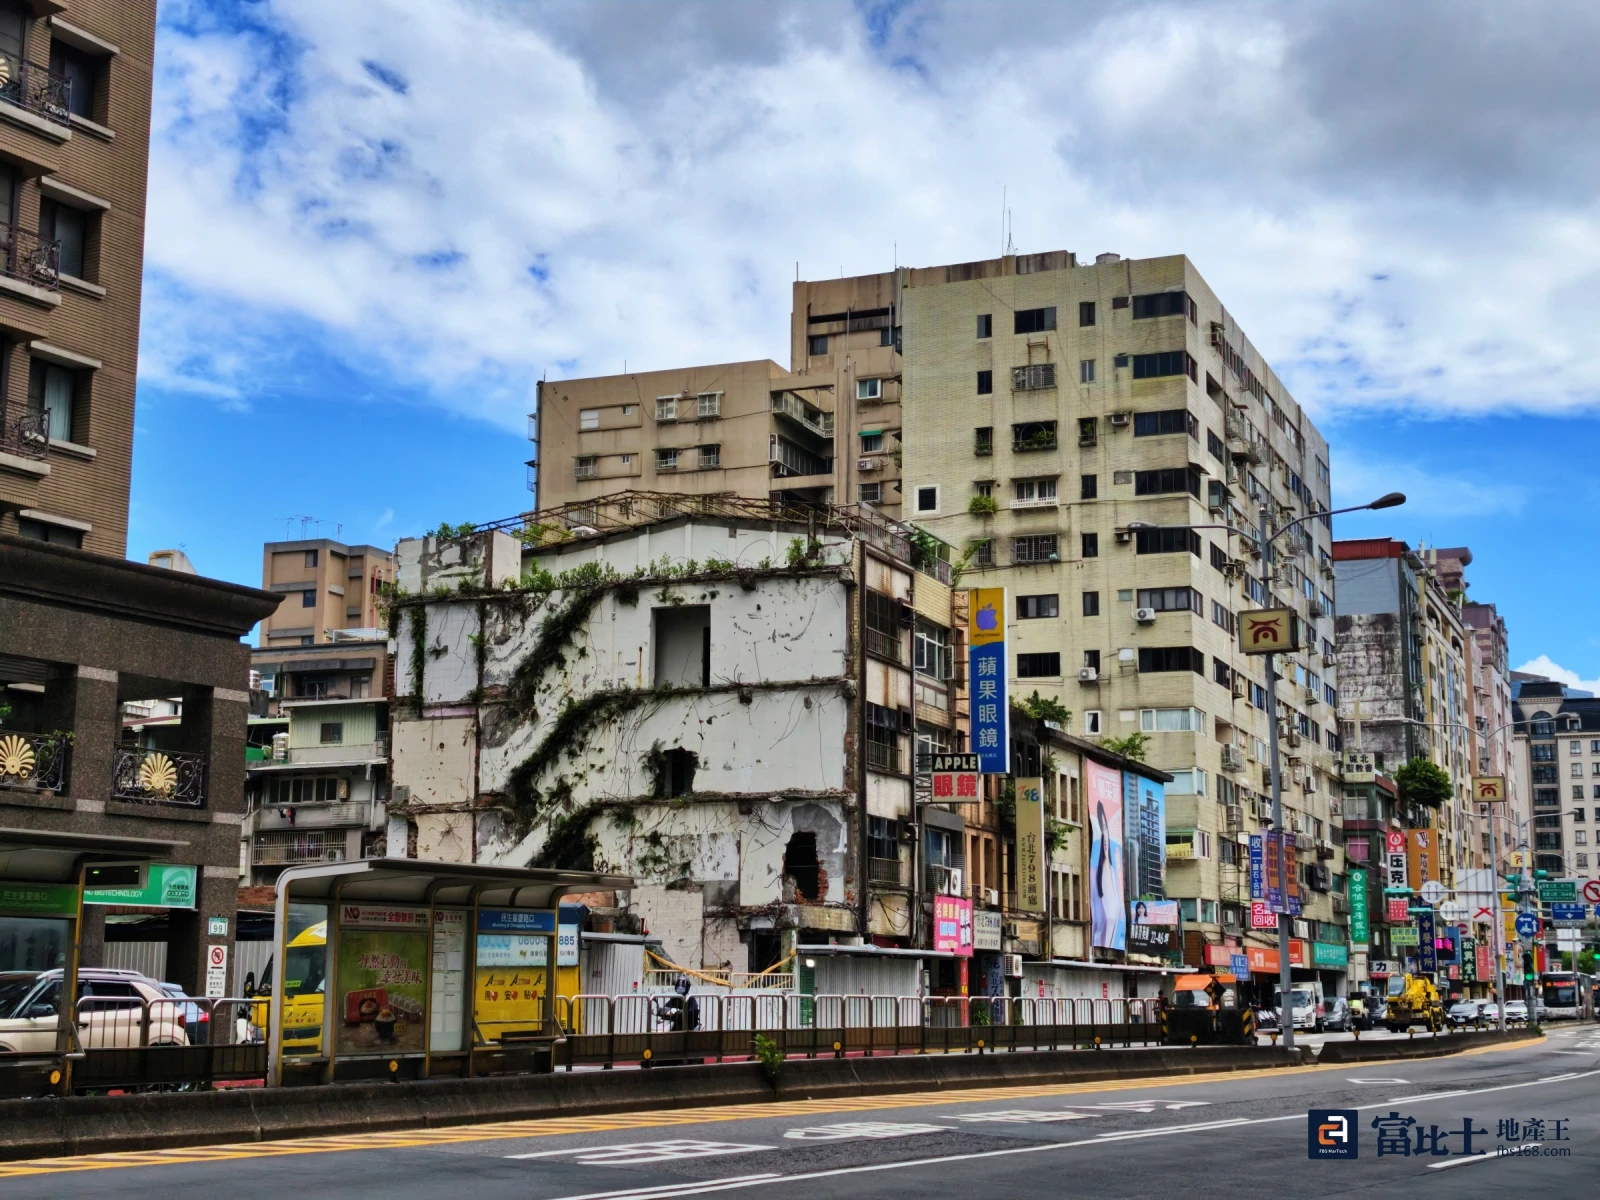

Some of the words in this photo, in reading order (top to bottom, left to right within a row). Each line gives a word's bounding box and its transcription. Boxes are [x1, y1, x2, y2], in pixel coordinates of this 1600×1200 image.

[978, 657, 998, 748] 蘋果眼鏡
[934, 756, 977, 770] APPLE
[1349, 752, 1369, 763] 城北
[934, 774, 977, 797] 眼鏡
[1018, 784, 1039, 802] 798
[344, 906, 361, 920] NO
[1253, 915, 1275, 926] 回收
[213, 924, 223, 932] 99
[504, 990, 512, 1001] 安
